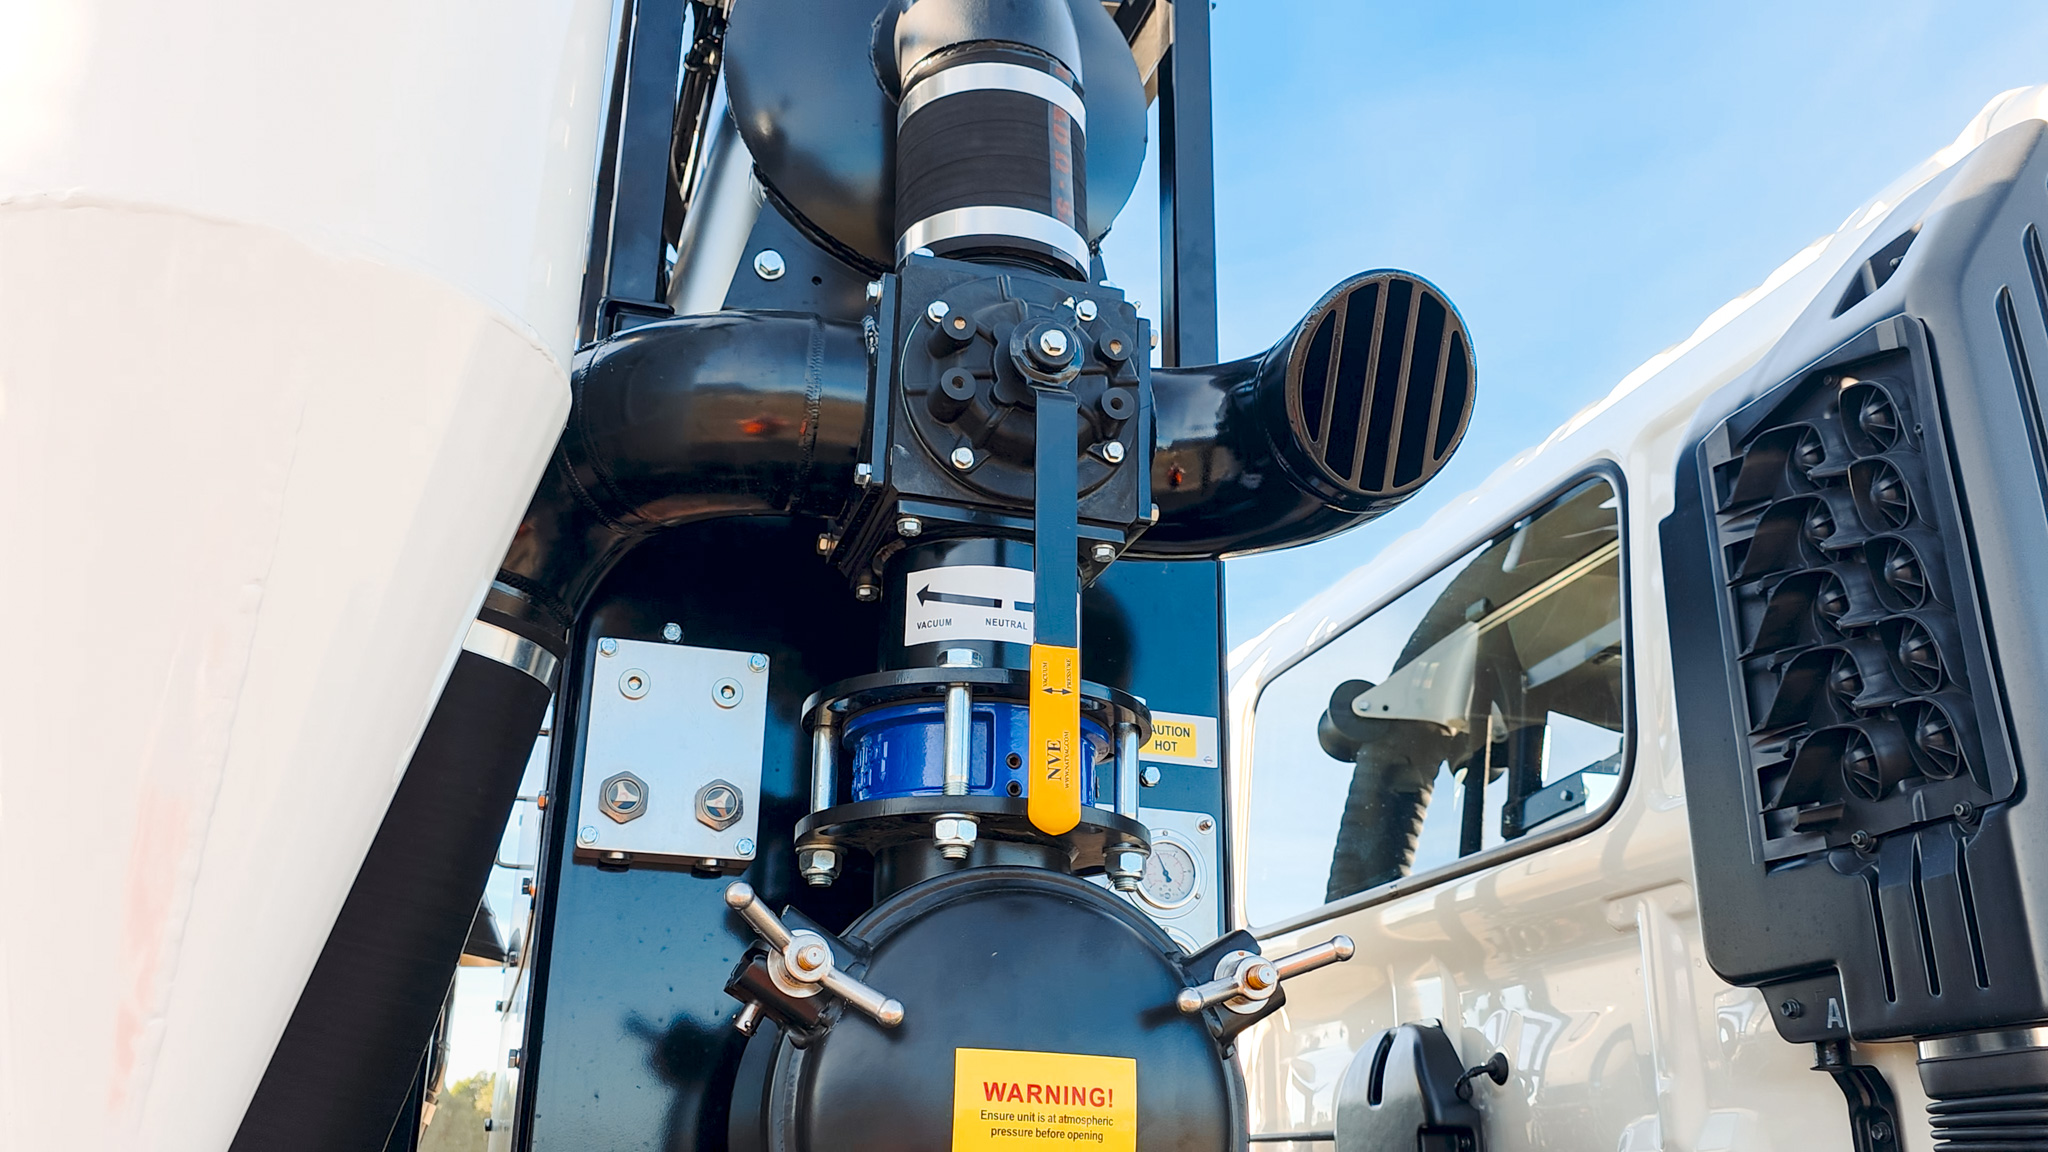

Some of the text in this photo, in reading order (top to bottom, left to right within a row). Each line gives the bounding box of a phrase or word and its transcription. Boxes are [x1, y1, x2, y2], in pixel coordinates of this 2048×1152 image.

[916, 617, 1028, 631] VACUUM NEUTRAL
[1151, 724, 1191, 738] AUTION
[1154, 739, 1178, 753] HOT
[1046, 739, 1062, 781] NVE
[1827, 997, 1845, 1029] A
[982, 1081, 1114, 1109] WARNING!
[980, 1109, 1114, 1128] Ensure unit is at atmospheric
[990, 1125, 1104, 1144] pressure before opening
